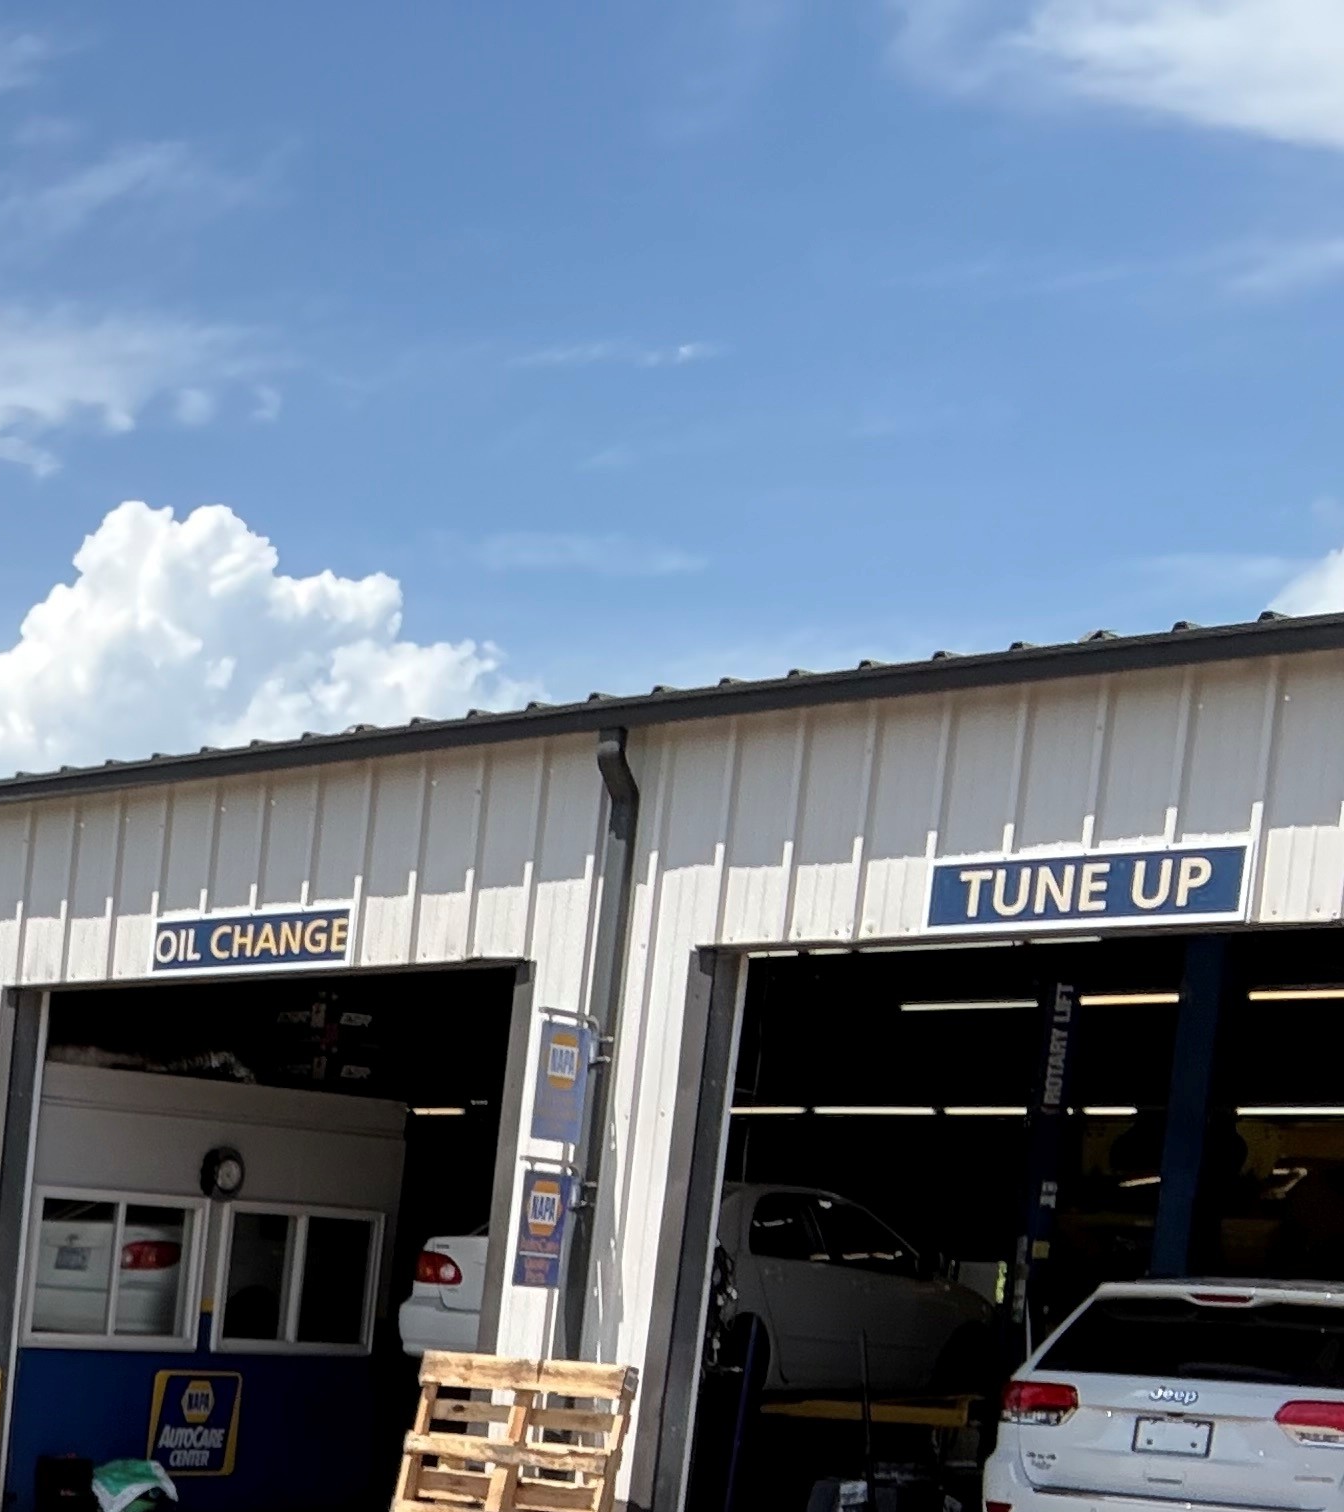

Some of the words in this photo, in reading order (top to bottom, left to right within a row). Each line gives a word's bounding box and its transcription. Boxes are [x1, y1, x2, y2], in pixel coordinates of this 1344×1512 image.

[960, 862, 1110, 918] TUNE
[1131, 857, 1212, 909] UP
[155, 929, 201, 964] OIL
[210, 917, 349, 960] CHANGE
[550, 1047, 576, 1076] NAPA
[531, 1195, 555, 1222] NAPA
[187, 1391, 210, 1412] NAPA
[1149, 1385, 1199, 1406] Jeep
[169, 1449, 210, 1467] CENTER
